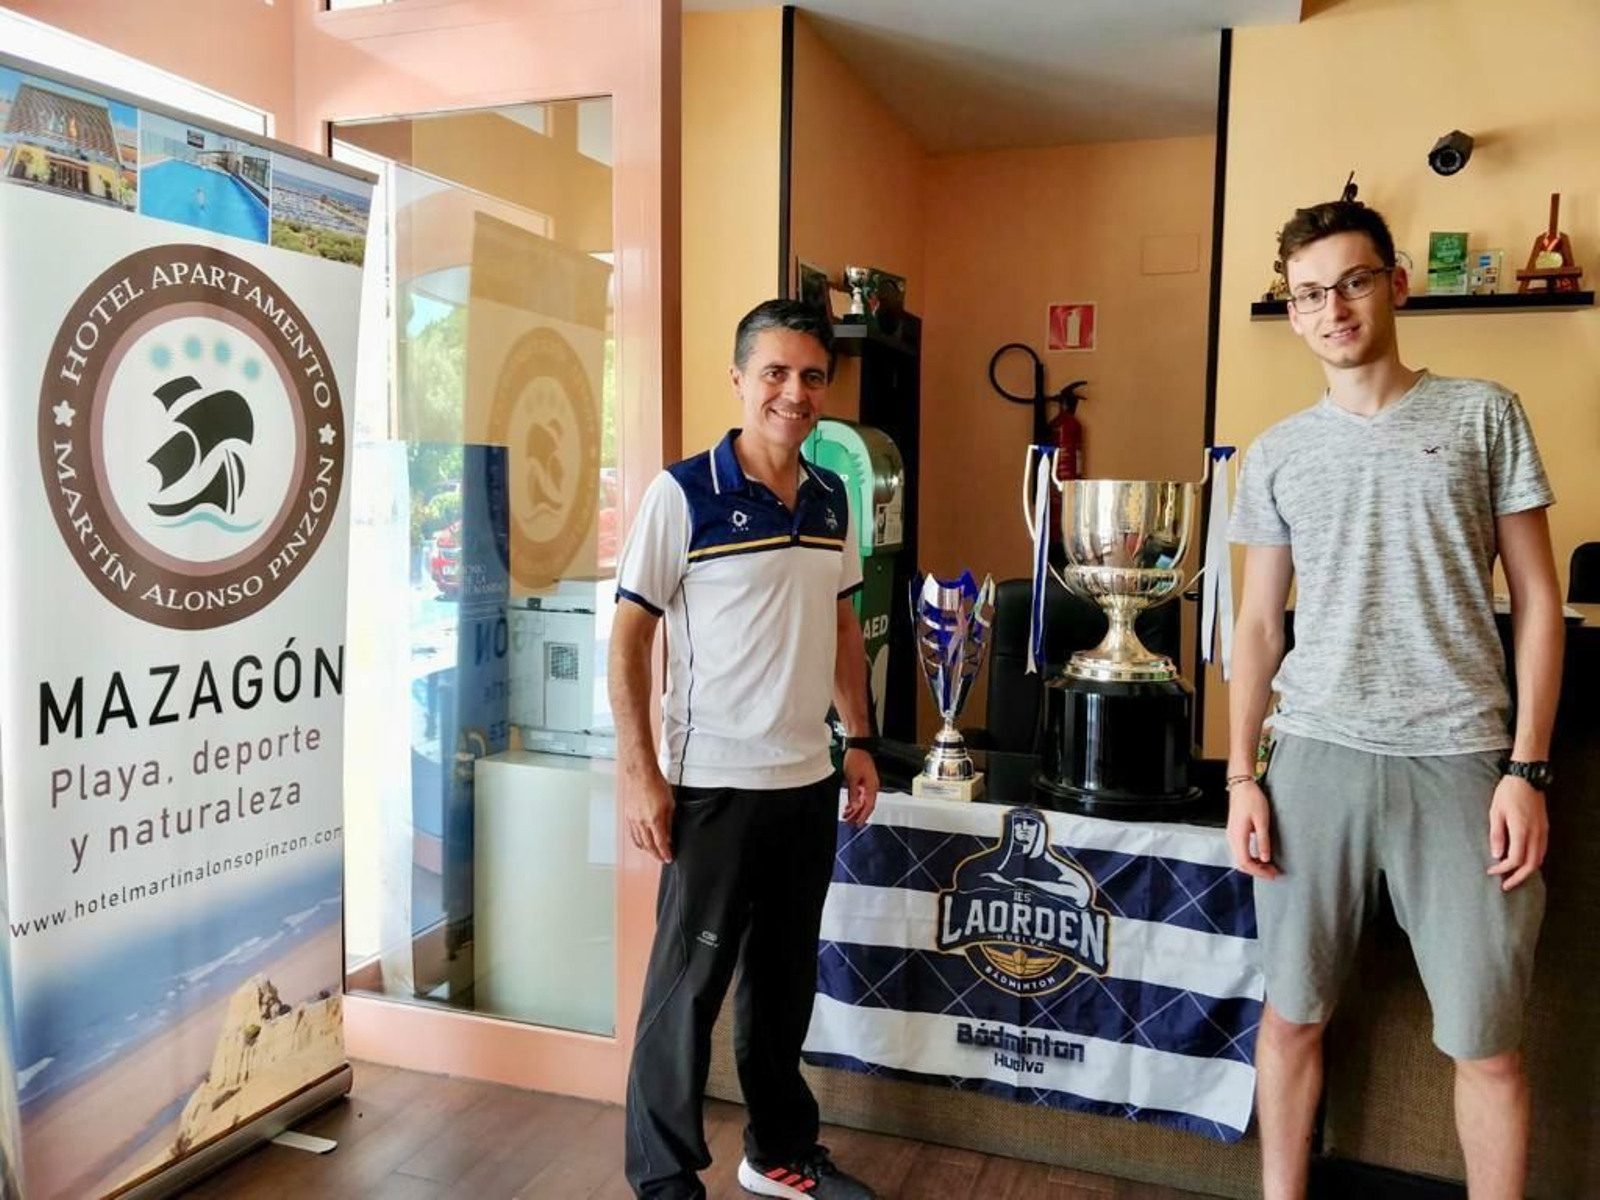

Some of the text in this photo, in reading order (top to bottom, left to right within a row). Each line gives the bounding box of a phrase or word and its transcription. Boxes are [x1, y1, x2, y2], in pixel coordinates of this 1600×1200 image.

[60, 262, 332, 409] HOTEL APARTAMENTO
[54, 439, 335, 612] MARTÍN ALONSO PINZÓN
[863, 614, 889, 639] AED
[39, 637, 344, 746] MAZAGÓN
[51, 725, 321, 809] Playa, deporte
[69, 780, 301, 873] y naturaleza
[956, 1020, 1086, 1063] Bádminton
[993, 1052, 1045, 1075] Huelva
